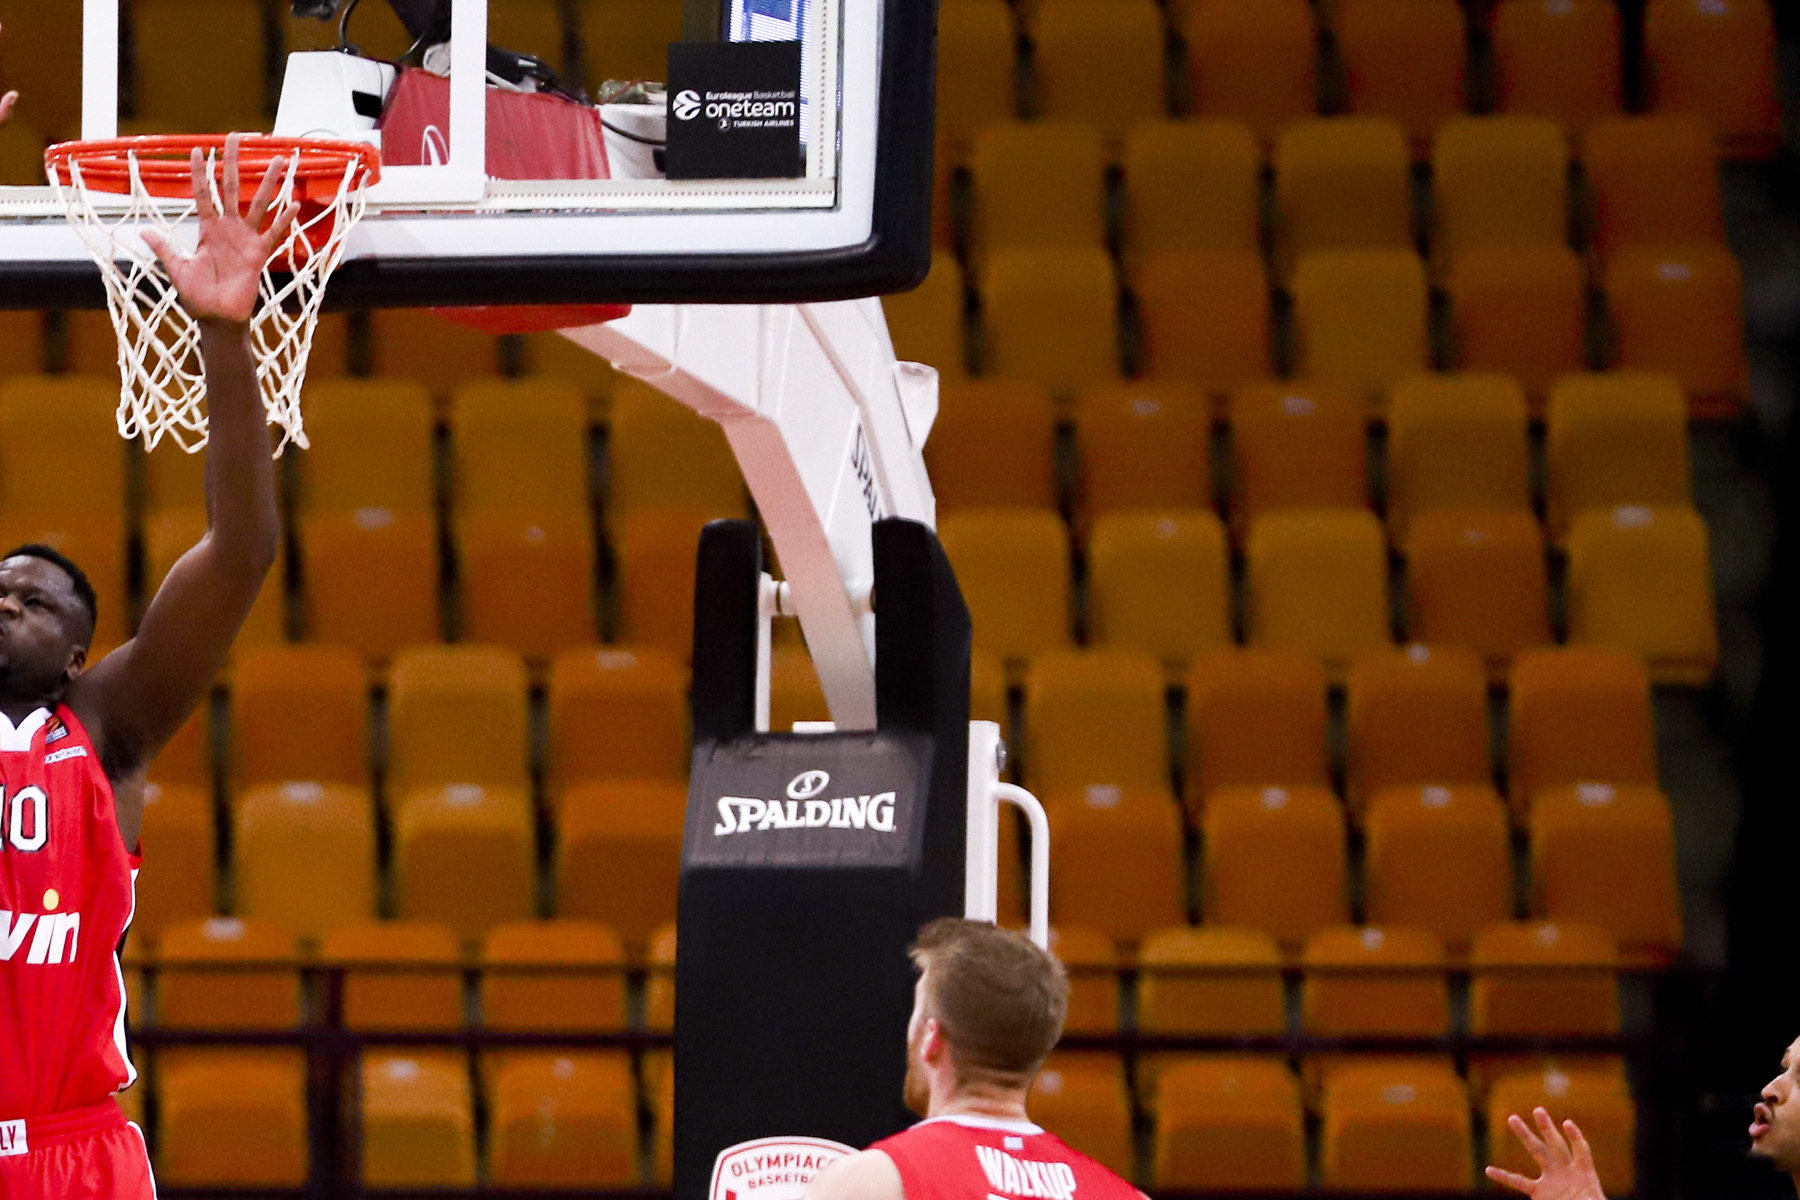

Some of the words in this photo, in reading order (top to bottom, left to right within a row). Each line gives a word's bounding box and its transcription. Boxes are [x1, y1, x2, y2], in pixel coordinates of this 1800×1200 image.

[705, 100, 795, 119] oneteam
[713, 791, 898, 838] SPALDING
[731, 1151, 838, 1178] OLYMPIAC
